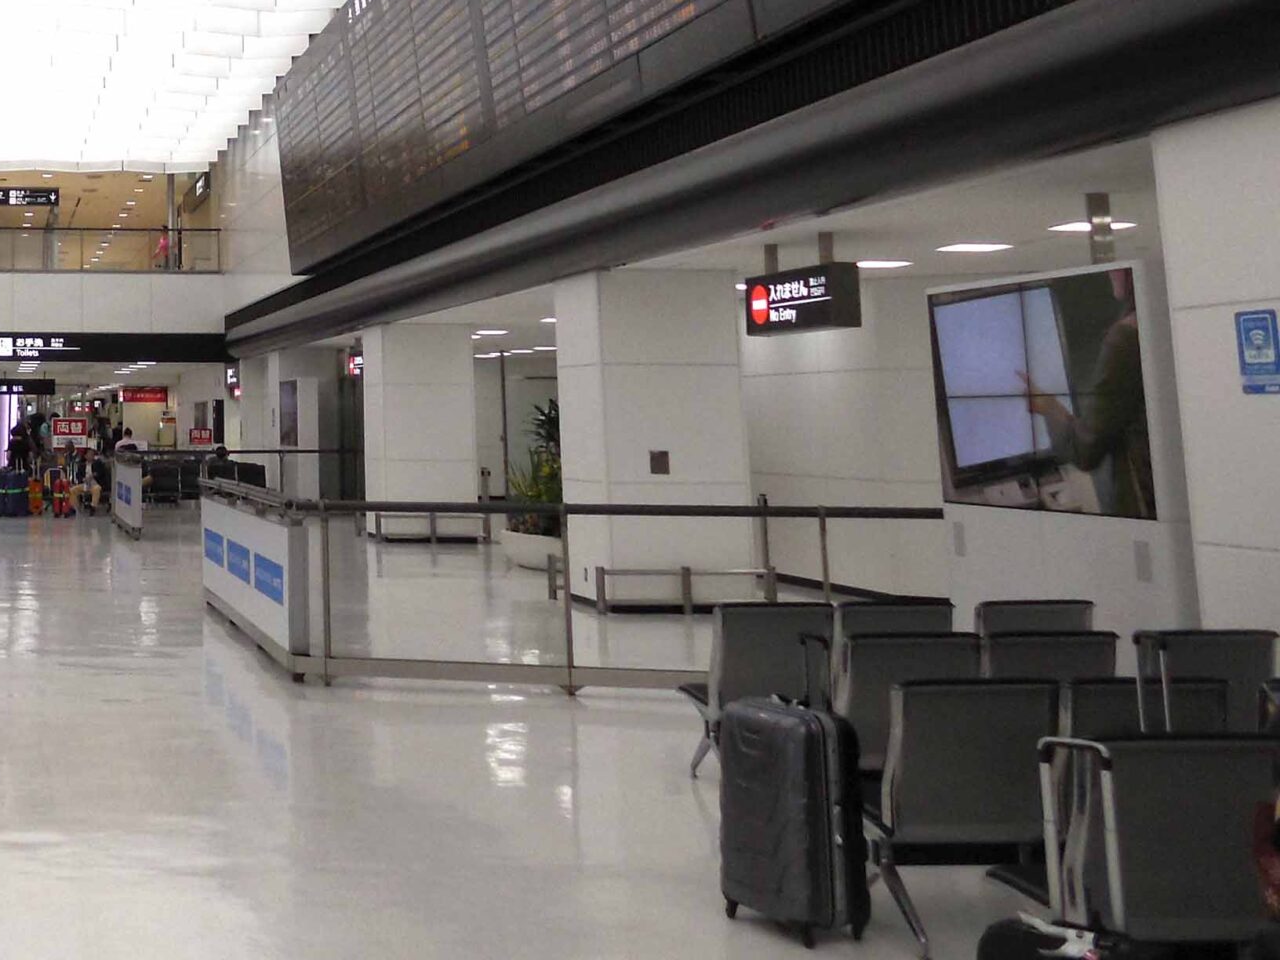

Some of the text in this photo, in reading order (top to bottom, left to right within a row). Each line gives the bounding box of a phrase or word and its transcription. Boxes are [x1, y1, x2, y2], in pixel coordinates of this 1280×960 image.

[769, 280, 808, 301] 入れません
[769, 308, 797, 324] No Entry
[16, 349, 39, 357] Toilets
[57, 421, 83, 434] 両替
